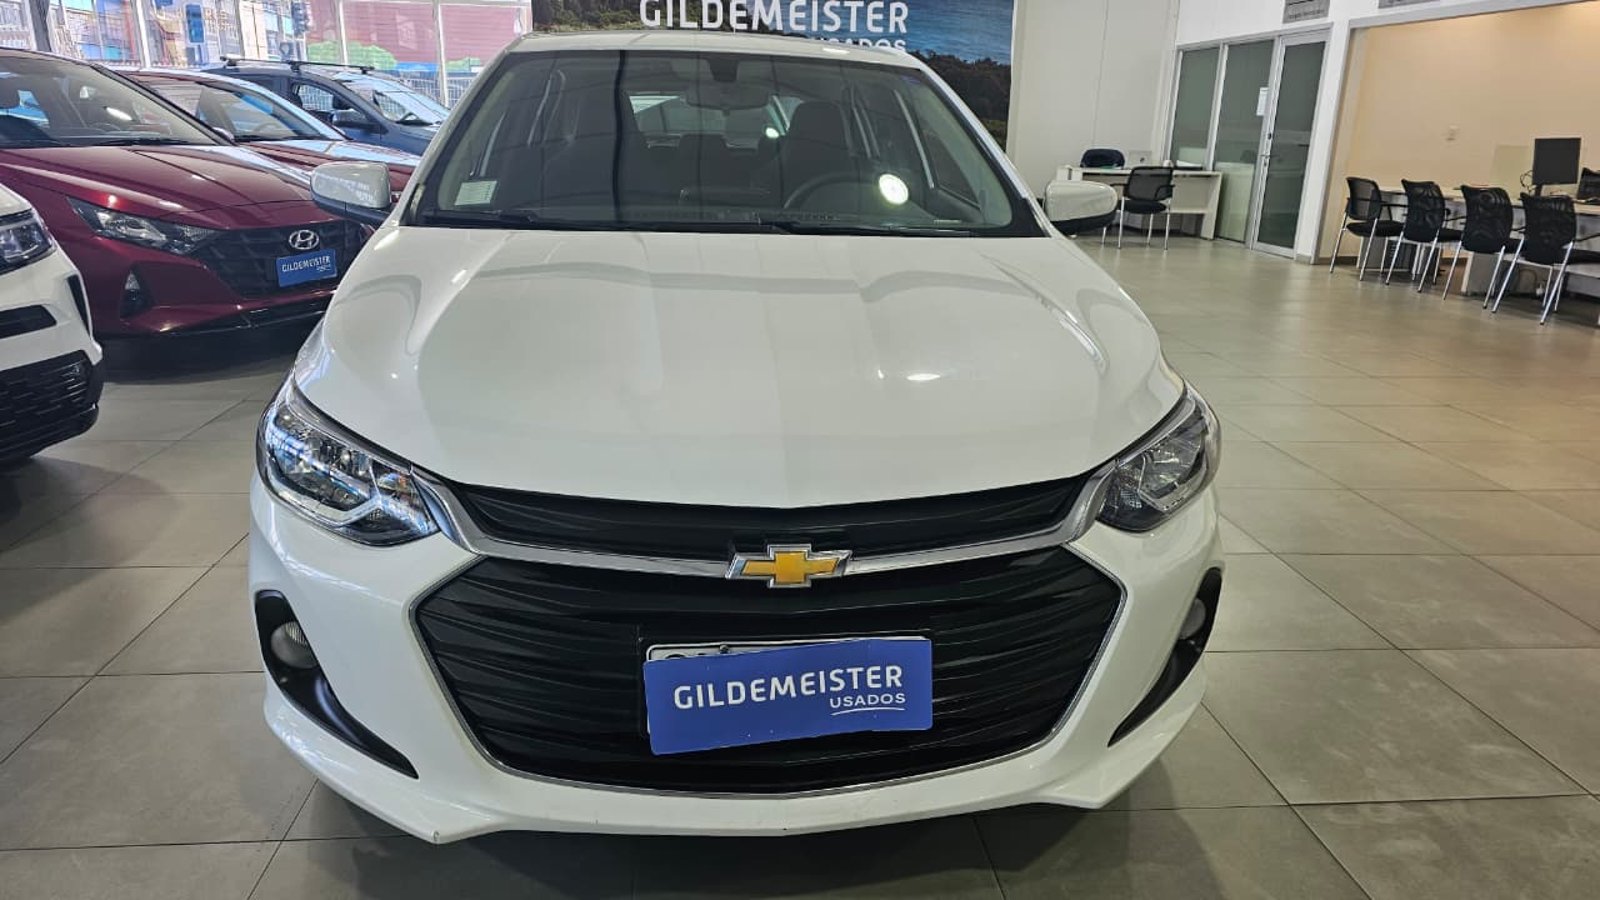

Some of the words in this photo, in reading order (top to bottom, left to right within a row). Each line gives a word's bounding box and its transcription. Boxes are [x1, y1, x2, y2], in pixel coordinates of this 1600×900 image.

[639, 0, 908, 33] GILDEMEISTER
[673, 665, 903, 709] GILDEMEISTER
[829, 692, 906, 708] USADOS
